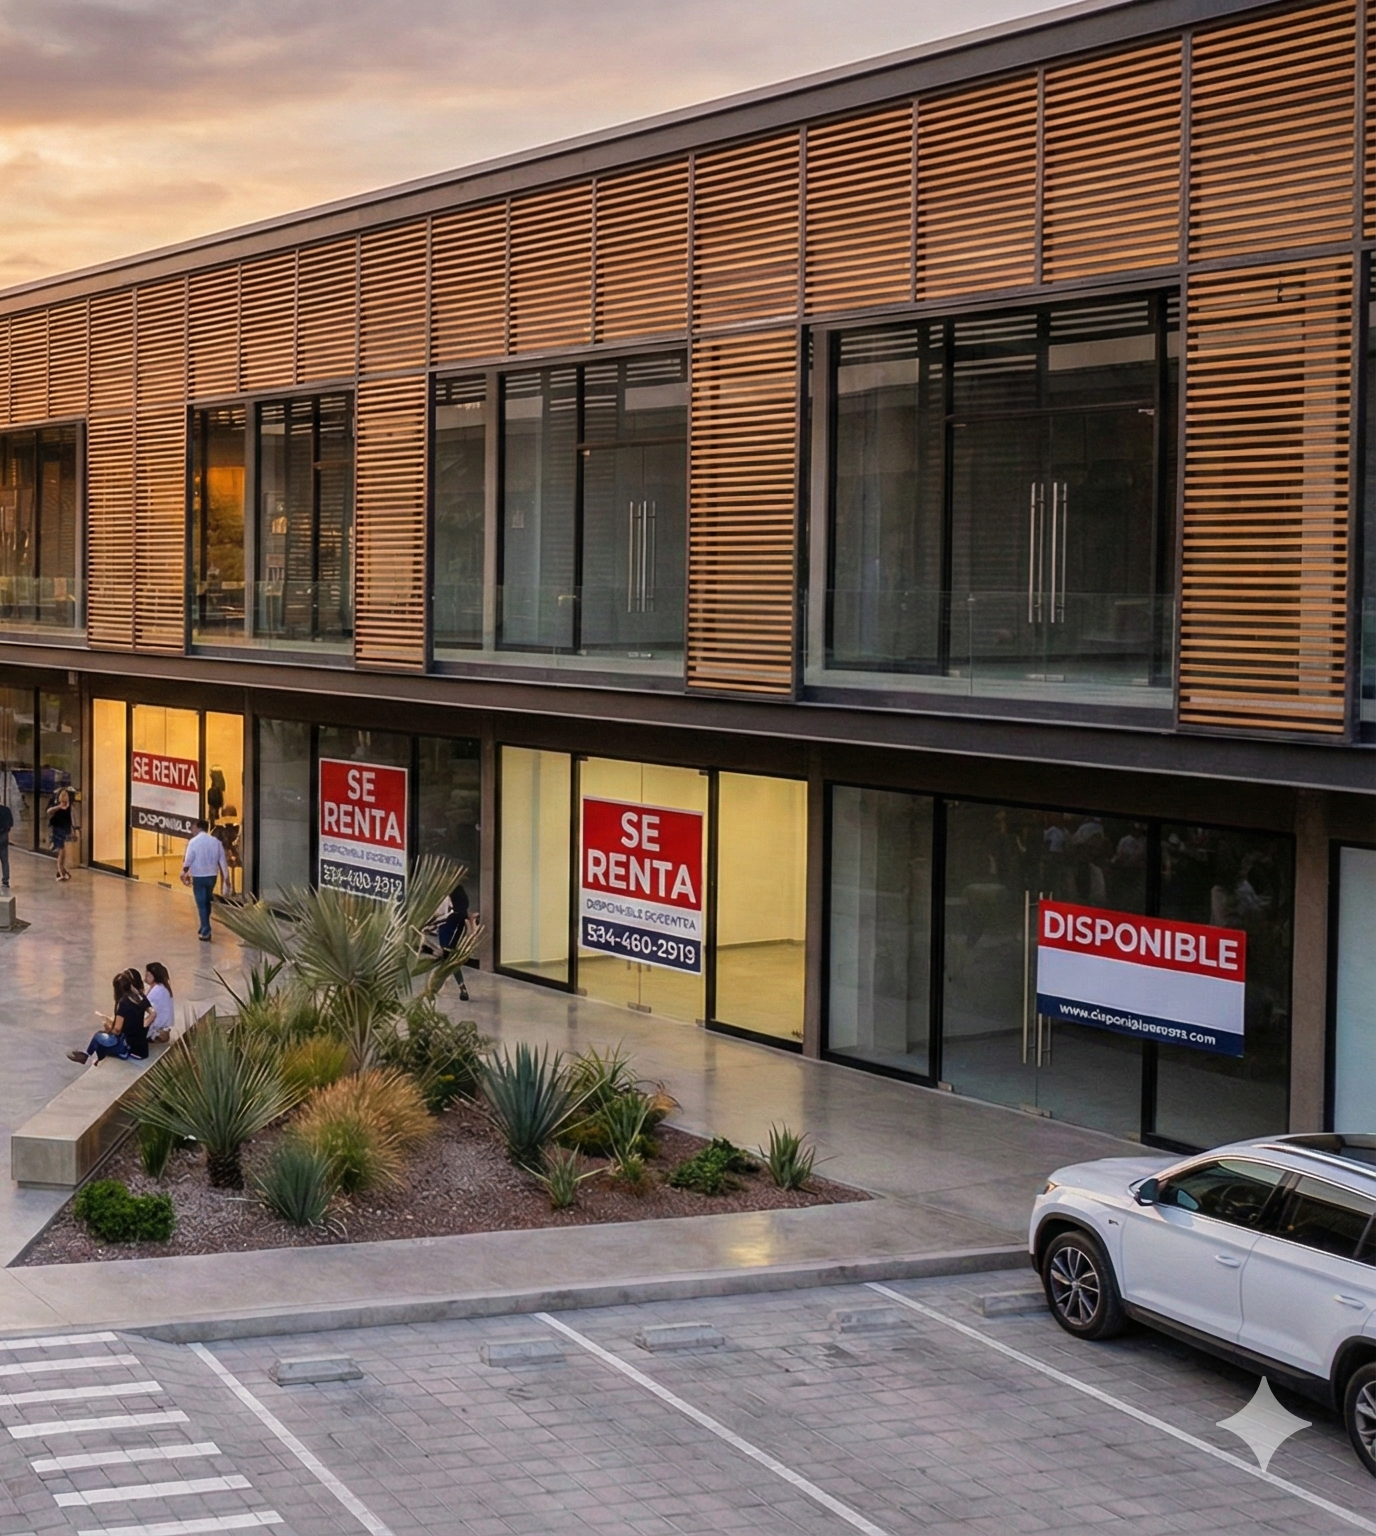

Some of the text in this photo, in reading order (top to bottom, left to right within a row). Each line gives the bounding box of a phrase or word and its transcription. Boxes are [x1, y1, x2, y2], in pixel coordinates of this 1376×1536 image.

[133, 756, 199, 790] SE RENTA
[347, 769, 376, 803] SE
[324, 801, 402, 844] RENTA
[621, 811, 660, 852] SE
[587, 848, 697, 904] RENTA
[1044, 910, 1239, 970] DISPONIBLE
